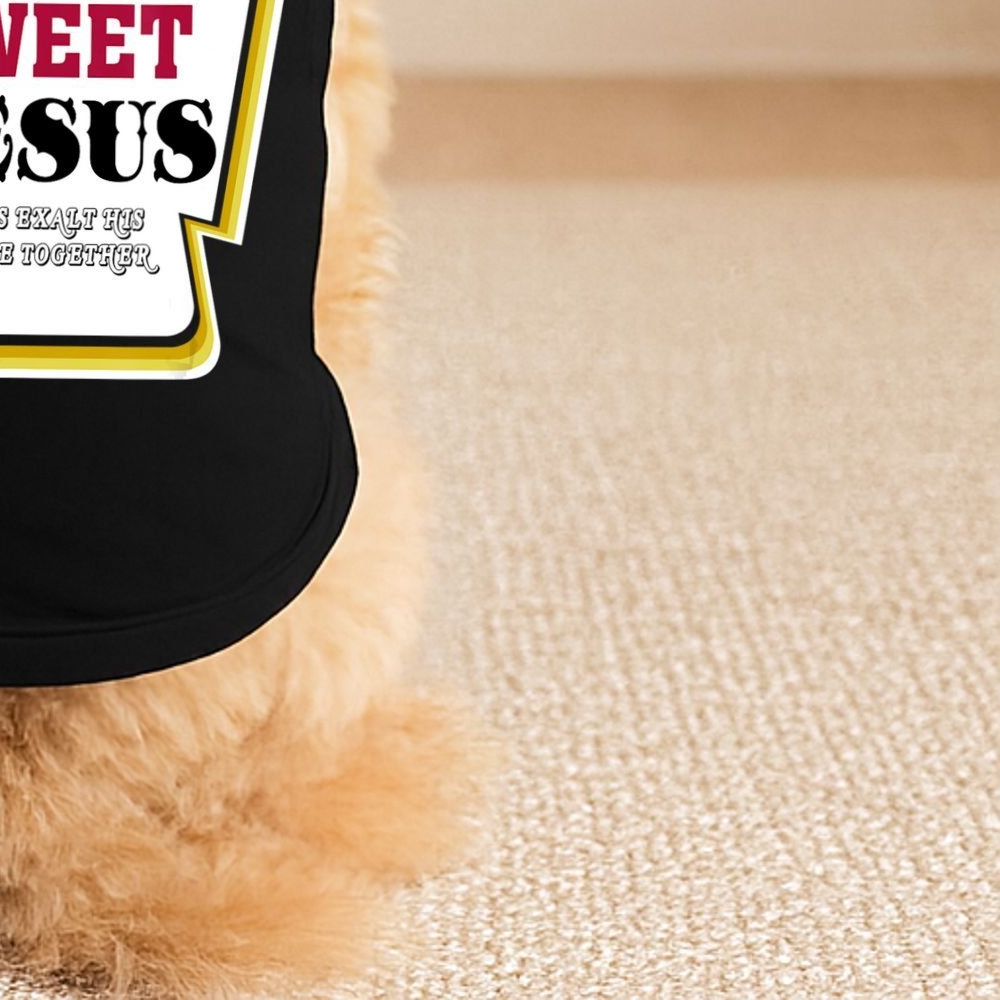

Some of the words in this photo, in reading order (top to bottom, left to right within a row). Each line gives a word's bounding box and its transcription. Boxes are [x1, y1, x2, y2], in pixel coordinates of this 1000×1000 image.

[15, 206, 97, 239] EXALT
[102, 207, 145, 240] HIS
[21, 242, 160, 276] TOGETHER
